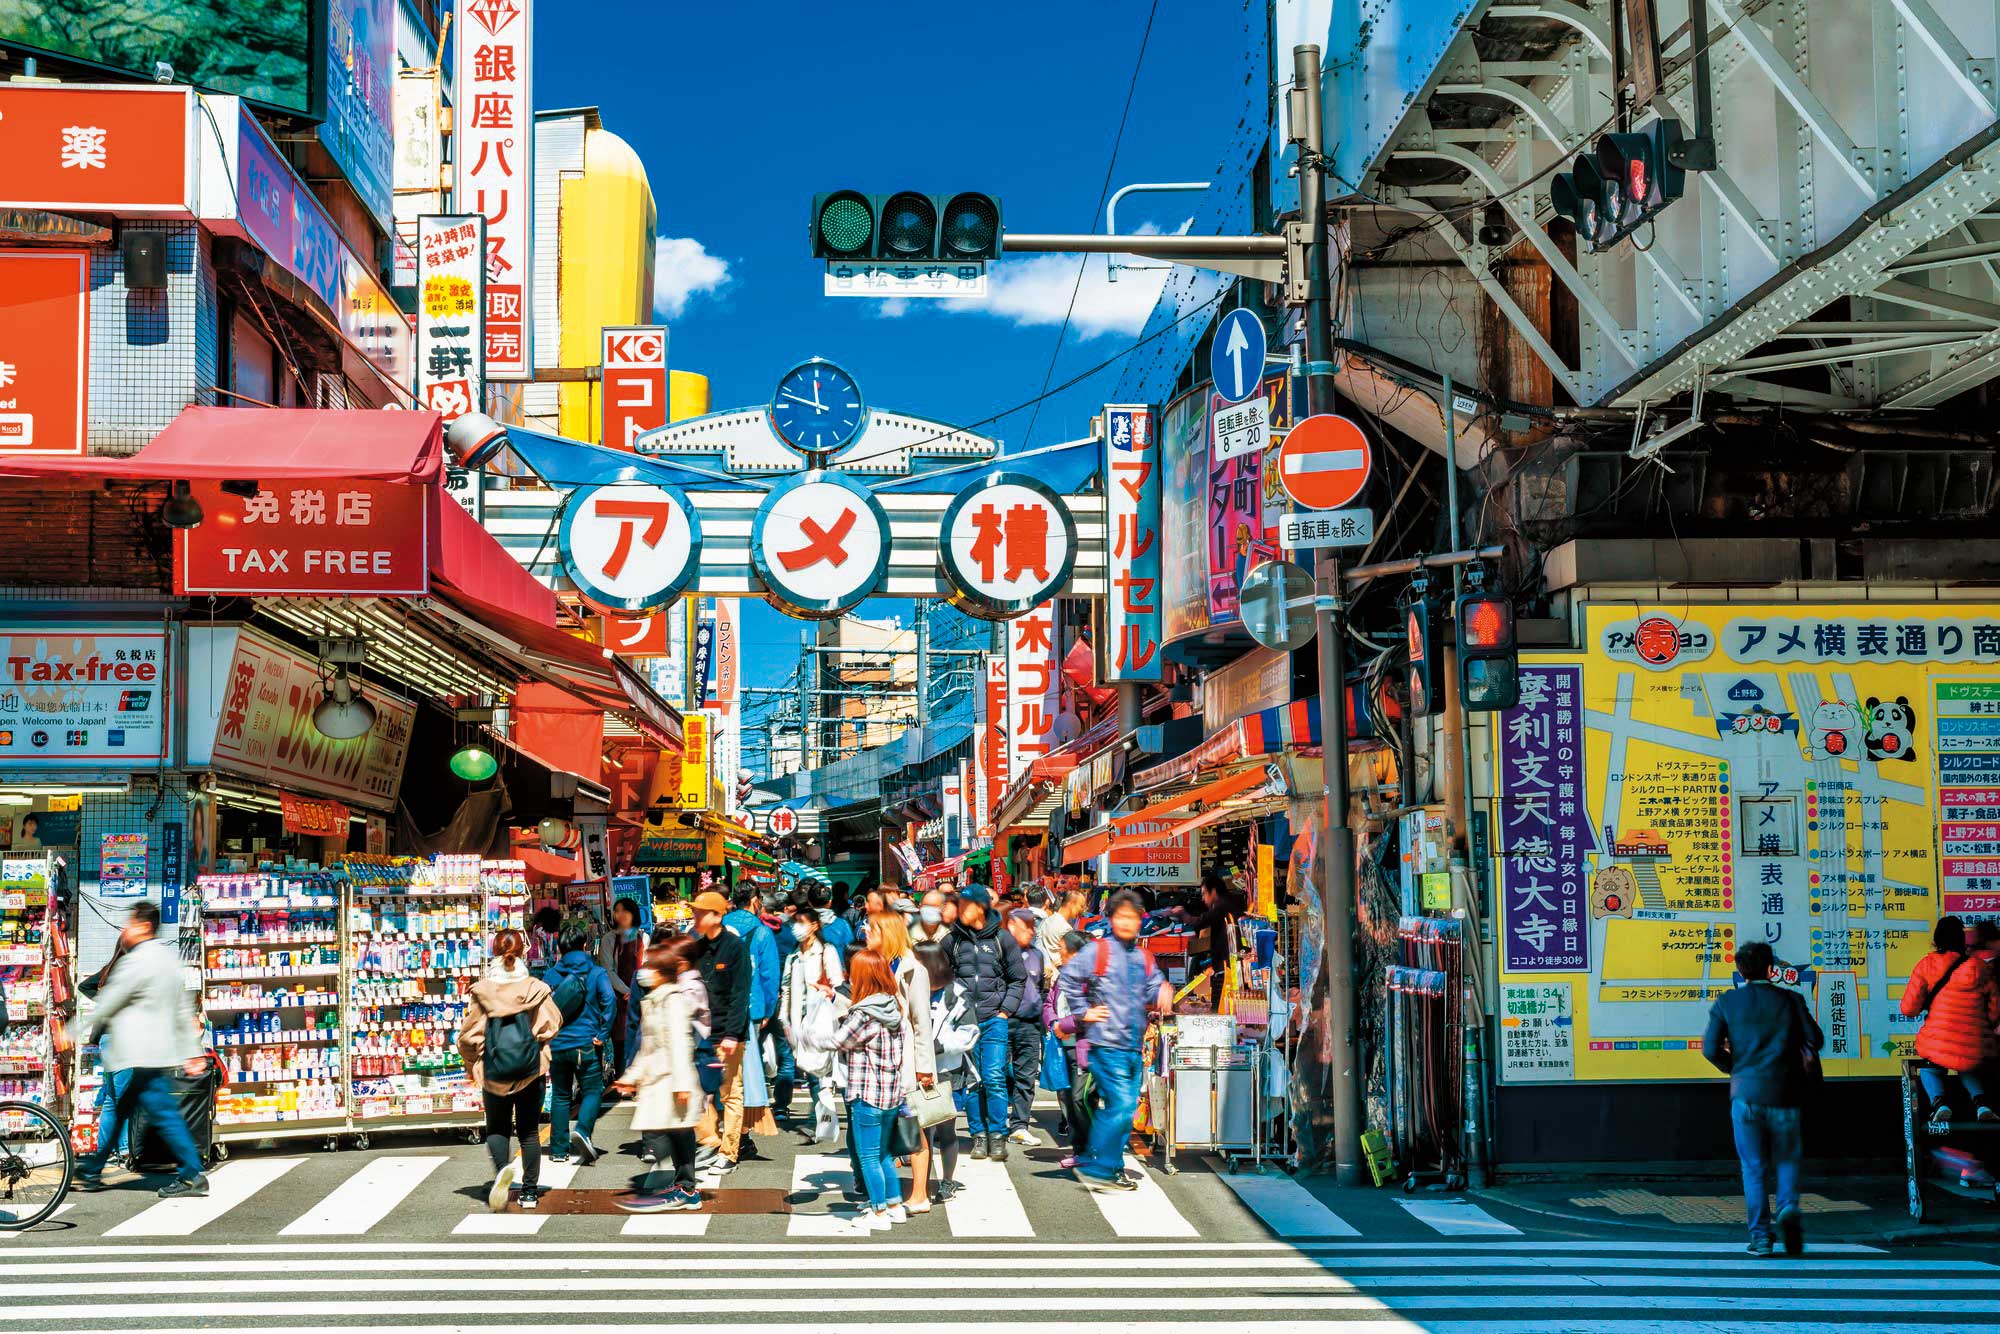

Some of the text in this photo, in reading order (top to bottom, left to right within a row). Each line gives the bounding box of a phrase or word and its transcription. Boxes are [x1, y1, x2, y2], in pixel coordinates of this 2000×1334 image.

[61, 126, 107, 169] 薬
[470, 44, 516, 271] 銀座パリス
[424, 224, 476, 250] 24時間
[426, 243, 475, 268] 営業中!
[836, 264, 977, 289] 自転車専用
[607, 335, 662, 362] KG
[1218, 406, 1264, 434] 自転車を除く
[1223, 437, 1230, 453] 8
[1247, 427, 1261, 446] 20
[242, 490, 372, 525] 免税店
[1287, 518, 1366, 542] 自転車を除く
[594, 499, 1050, 584] アメ横
[222, 549, 392, 574] TAX FREE
[1111, 462, 1156, 672] マルセル
[1738, 624, 2000, 657] アメ横表通り商
[115, 649, 156, 661] 免税店
[8, 656, 157, 682] Tax-free
[1649, 685, 1703, 693] アメ横センタービル
[1733, 688, 1758, 698] 上野駅
[223, 660, 256, 740] 薬
[24, 701, 109, 714] 欢迎您光临日本!
[22, 717, 62, 726] Welcome
[66, 717, 74, 725] to
[78, 717, 106, 726] Japan!
[1735, 716, 1782, 731] アメ横
[1555, 674, 1575, 818] 開運勝利の守護神
[1656, 762, 1717, 771] ドヴステーラー
[1943, 757, 2000, 768] シルクロード
[1611, 773, 1717, 782] ロンドンスポーツ 表通り店
[1631, 785, 1680, 794] シルクロード
[1818, 782, 1853, 791] 中田商店
[676, 793, 698, 803] 入口
[1819, 796, 1889, 805] 珍味エクスプレス
[1636, 808, 1718, 817] 上野アメ横 タワラ屋
[1650, 819, 1719, 828] 浜屋食品第3号店
[1819, 822, 1889, 831] シルクロード本店
[1666, 830, 1719, 839] カワチヤ食品
[1945, 826, 1997, 839] 上野アメ横
[651, 838, 703, 850] Welcome
[1692, 842, 1719, 851] 珍味堂
[1685, 854, 1719, 863] ダイマス
[1820, 849, 1928, 859] ロンドンスポーツ アメ横店
[1758, 782, 1785, 944] アメ横表通り
[1952, 861, 2000, 874] 浜屋食品
[1121, 866, 1180, 877] マルセル店
[1676, 877, 1720, 886] 大津屋商店
[1821, 874, 1847, 883] アメ横
[1685, 888, 1720, 897] 大東商店
[1822, 888, 1929, 897] ロンドンスポーツ 御徒町店
[1667, 900, 1721, 909] 浜屋食品本店
[1822, 903, 1872, 912] シルクロード
[1964, 897, 2000, 909] カワチ
[1669, 929, 1721, 938] みなとや食品
[1823, 930, 1909, 939] コトブキゴルフ 北口店
[1824, 942, 1898, 950] サッカーけんちゃん
[1511, 955, 1584, 967] ココより徒歩30秒
[1695, 954, 1722, 963] 伊勢屋
[1825, 957, 1866, 966] 二木ゴルフ
[1830, 981, 1847, 1053] JR御徒町駅
[1521, 1018, 1554, 1028] お願い
[1507, 1030, 1568, 1039] 自動車等が した
[1554, 1040, 1568, 1048] 至急
[1507, 1049, 1552, 1058] 御連絡下さい。
[1507, 1061, 1535, 1069] JR東日本
